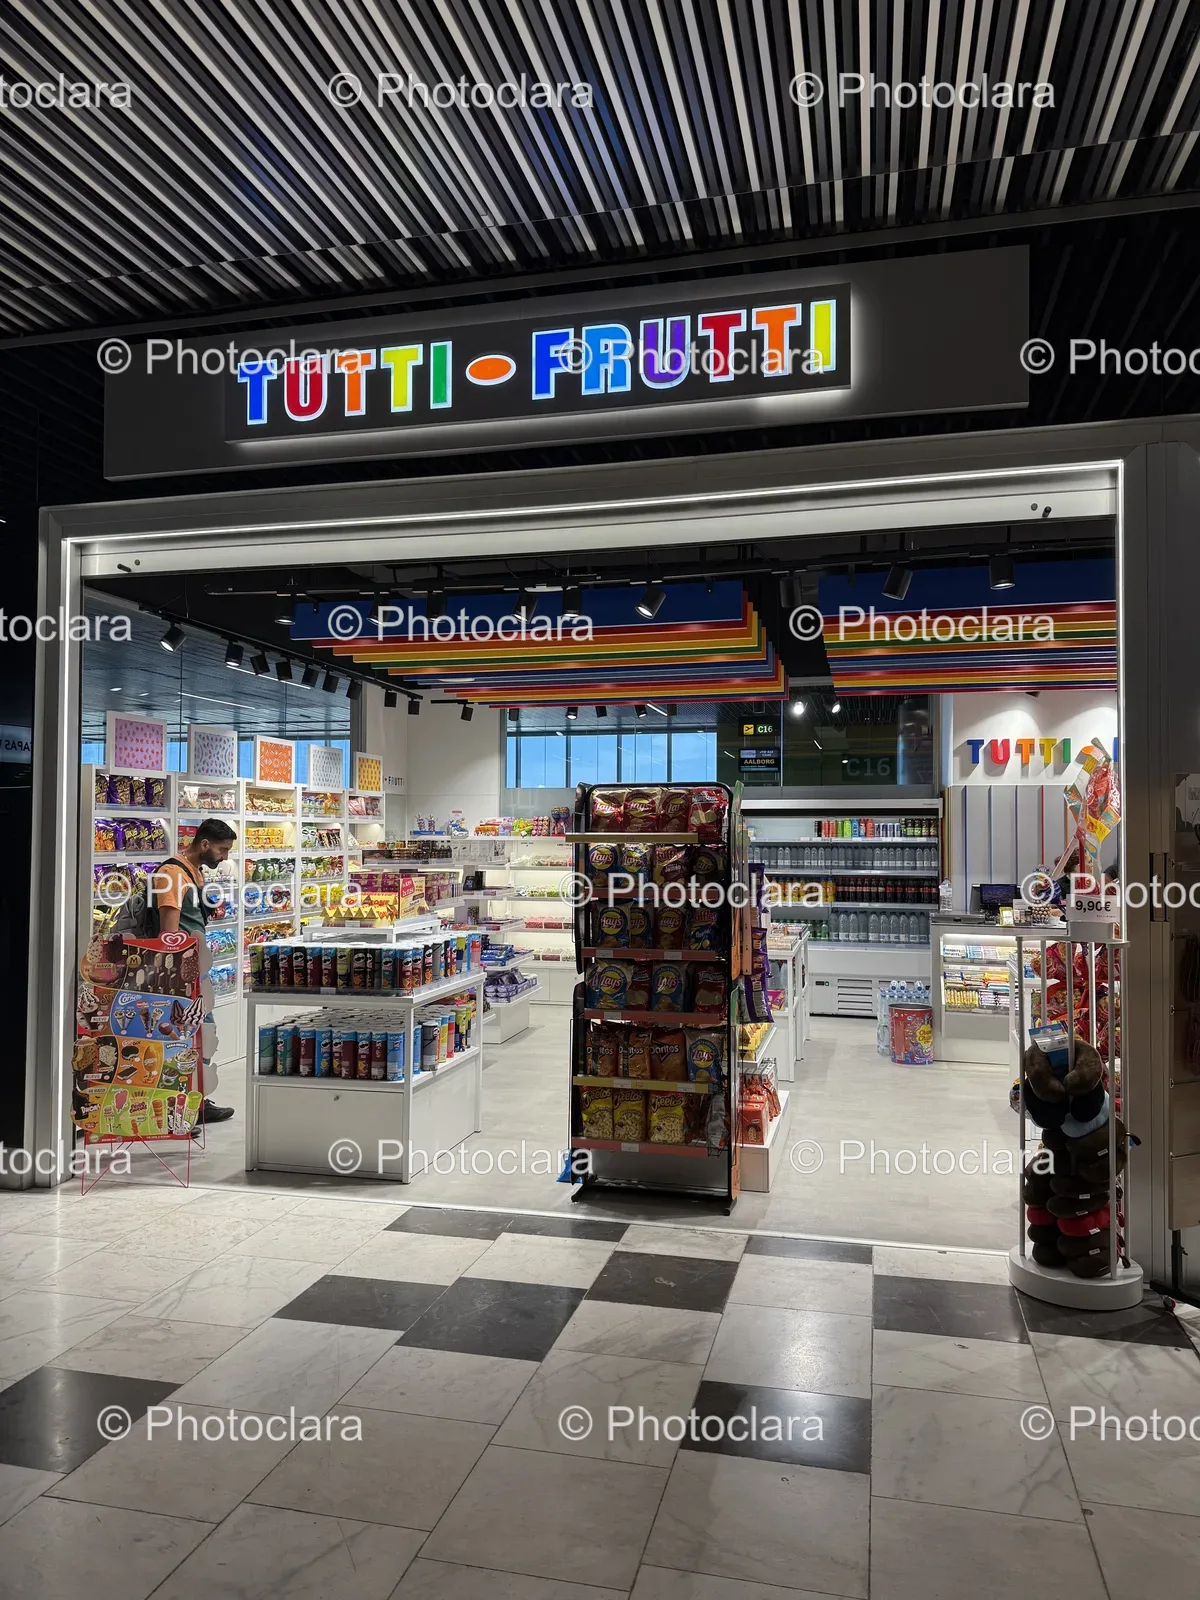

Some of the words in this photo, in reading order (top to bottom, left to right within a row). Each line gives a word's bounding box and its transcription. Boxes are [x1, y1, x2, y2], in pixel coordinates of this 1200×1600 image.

[238, 340, 452, 425] TUTTI
[532, 299, 836, 400] FRUTTI
[757, 725, 773, 733] C16
[966, 737, 1071, 765] TUTTI
[846, 757, 891, 776] C16
[1075, 900, 1112, 913] 9,90€
